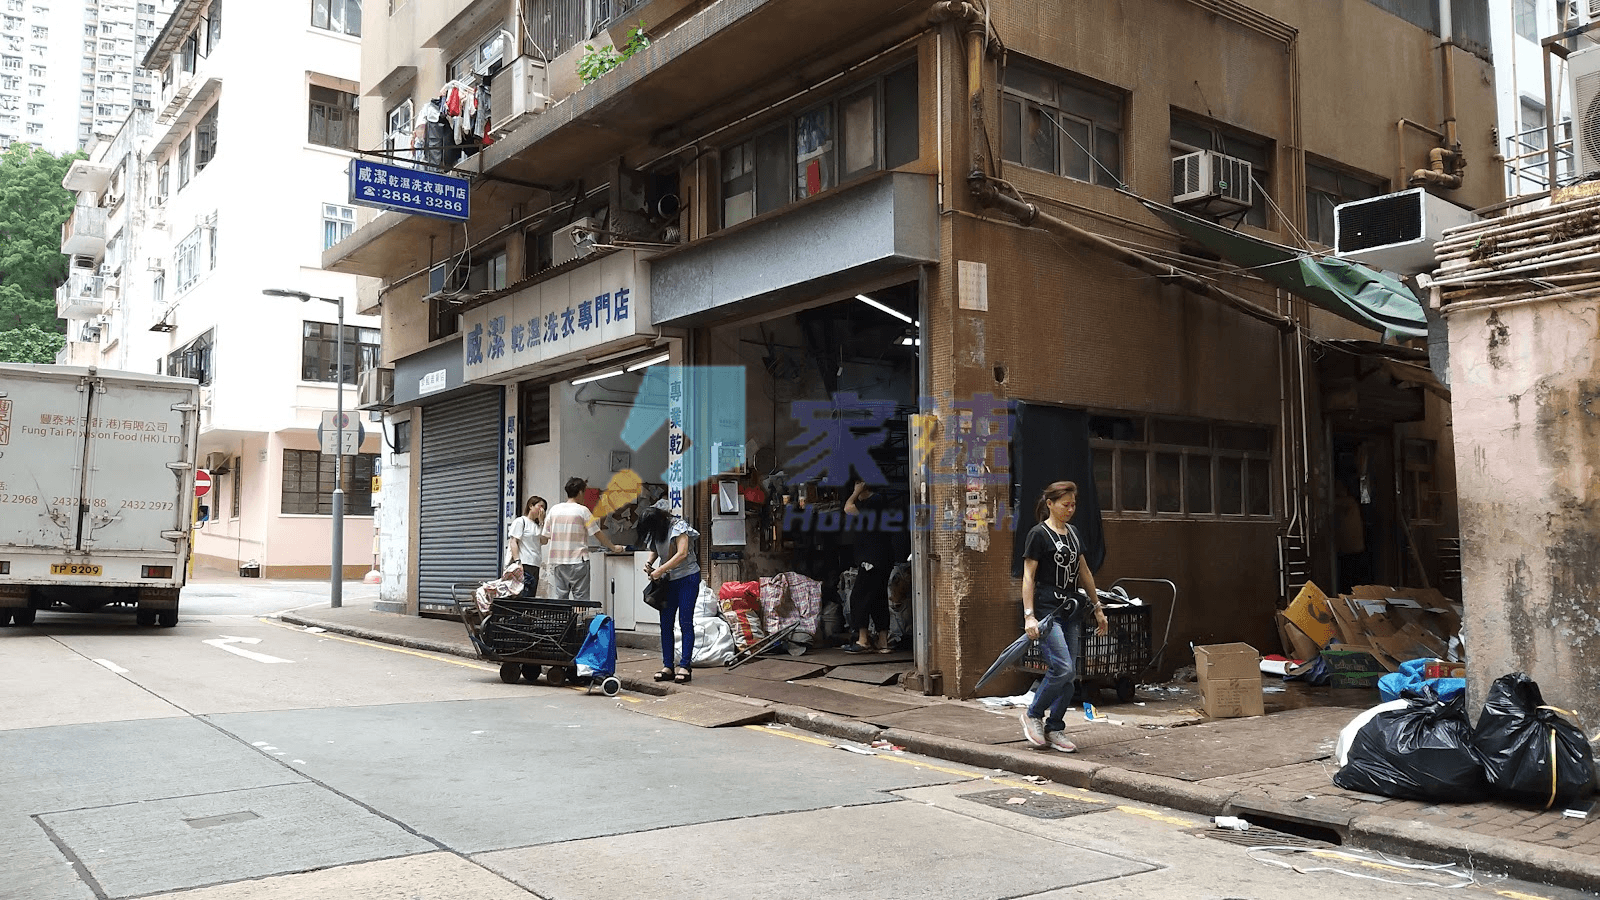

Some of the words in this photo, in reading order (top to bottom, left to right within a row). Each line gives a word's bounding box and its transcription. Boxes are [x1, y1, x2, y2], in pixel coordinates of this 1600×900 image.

[425, 196, 462, 212] 3286
[22, 425, 47, 437] Fung
[50, 427, 64, 437] Tai
[113, 432, 138, 441] Food
[140, 434, 160, 444] (HK)
[670, 381, 682, 519] 專業乾洗快
[12, 494, 38, 505] 2968
[52, 496, 79, 507] 2432
[121, 499, 146, 510] 2432
[149, 501, 174, 511] 2972
[53, 565, 67, 574] TP
[71, 565, 99, 574] 8209
